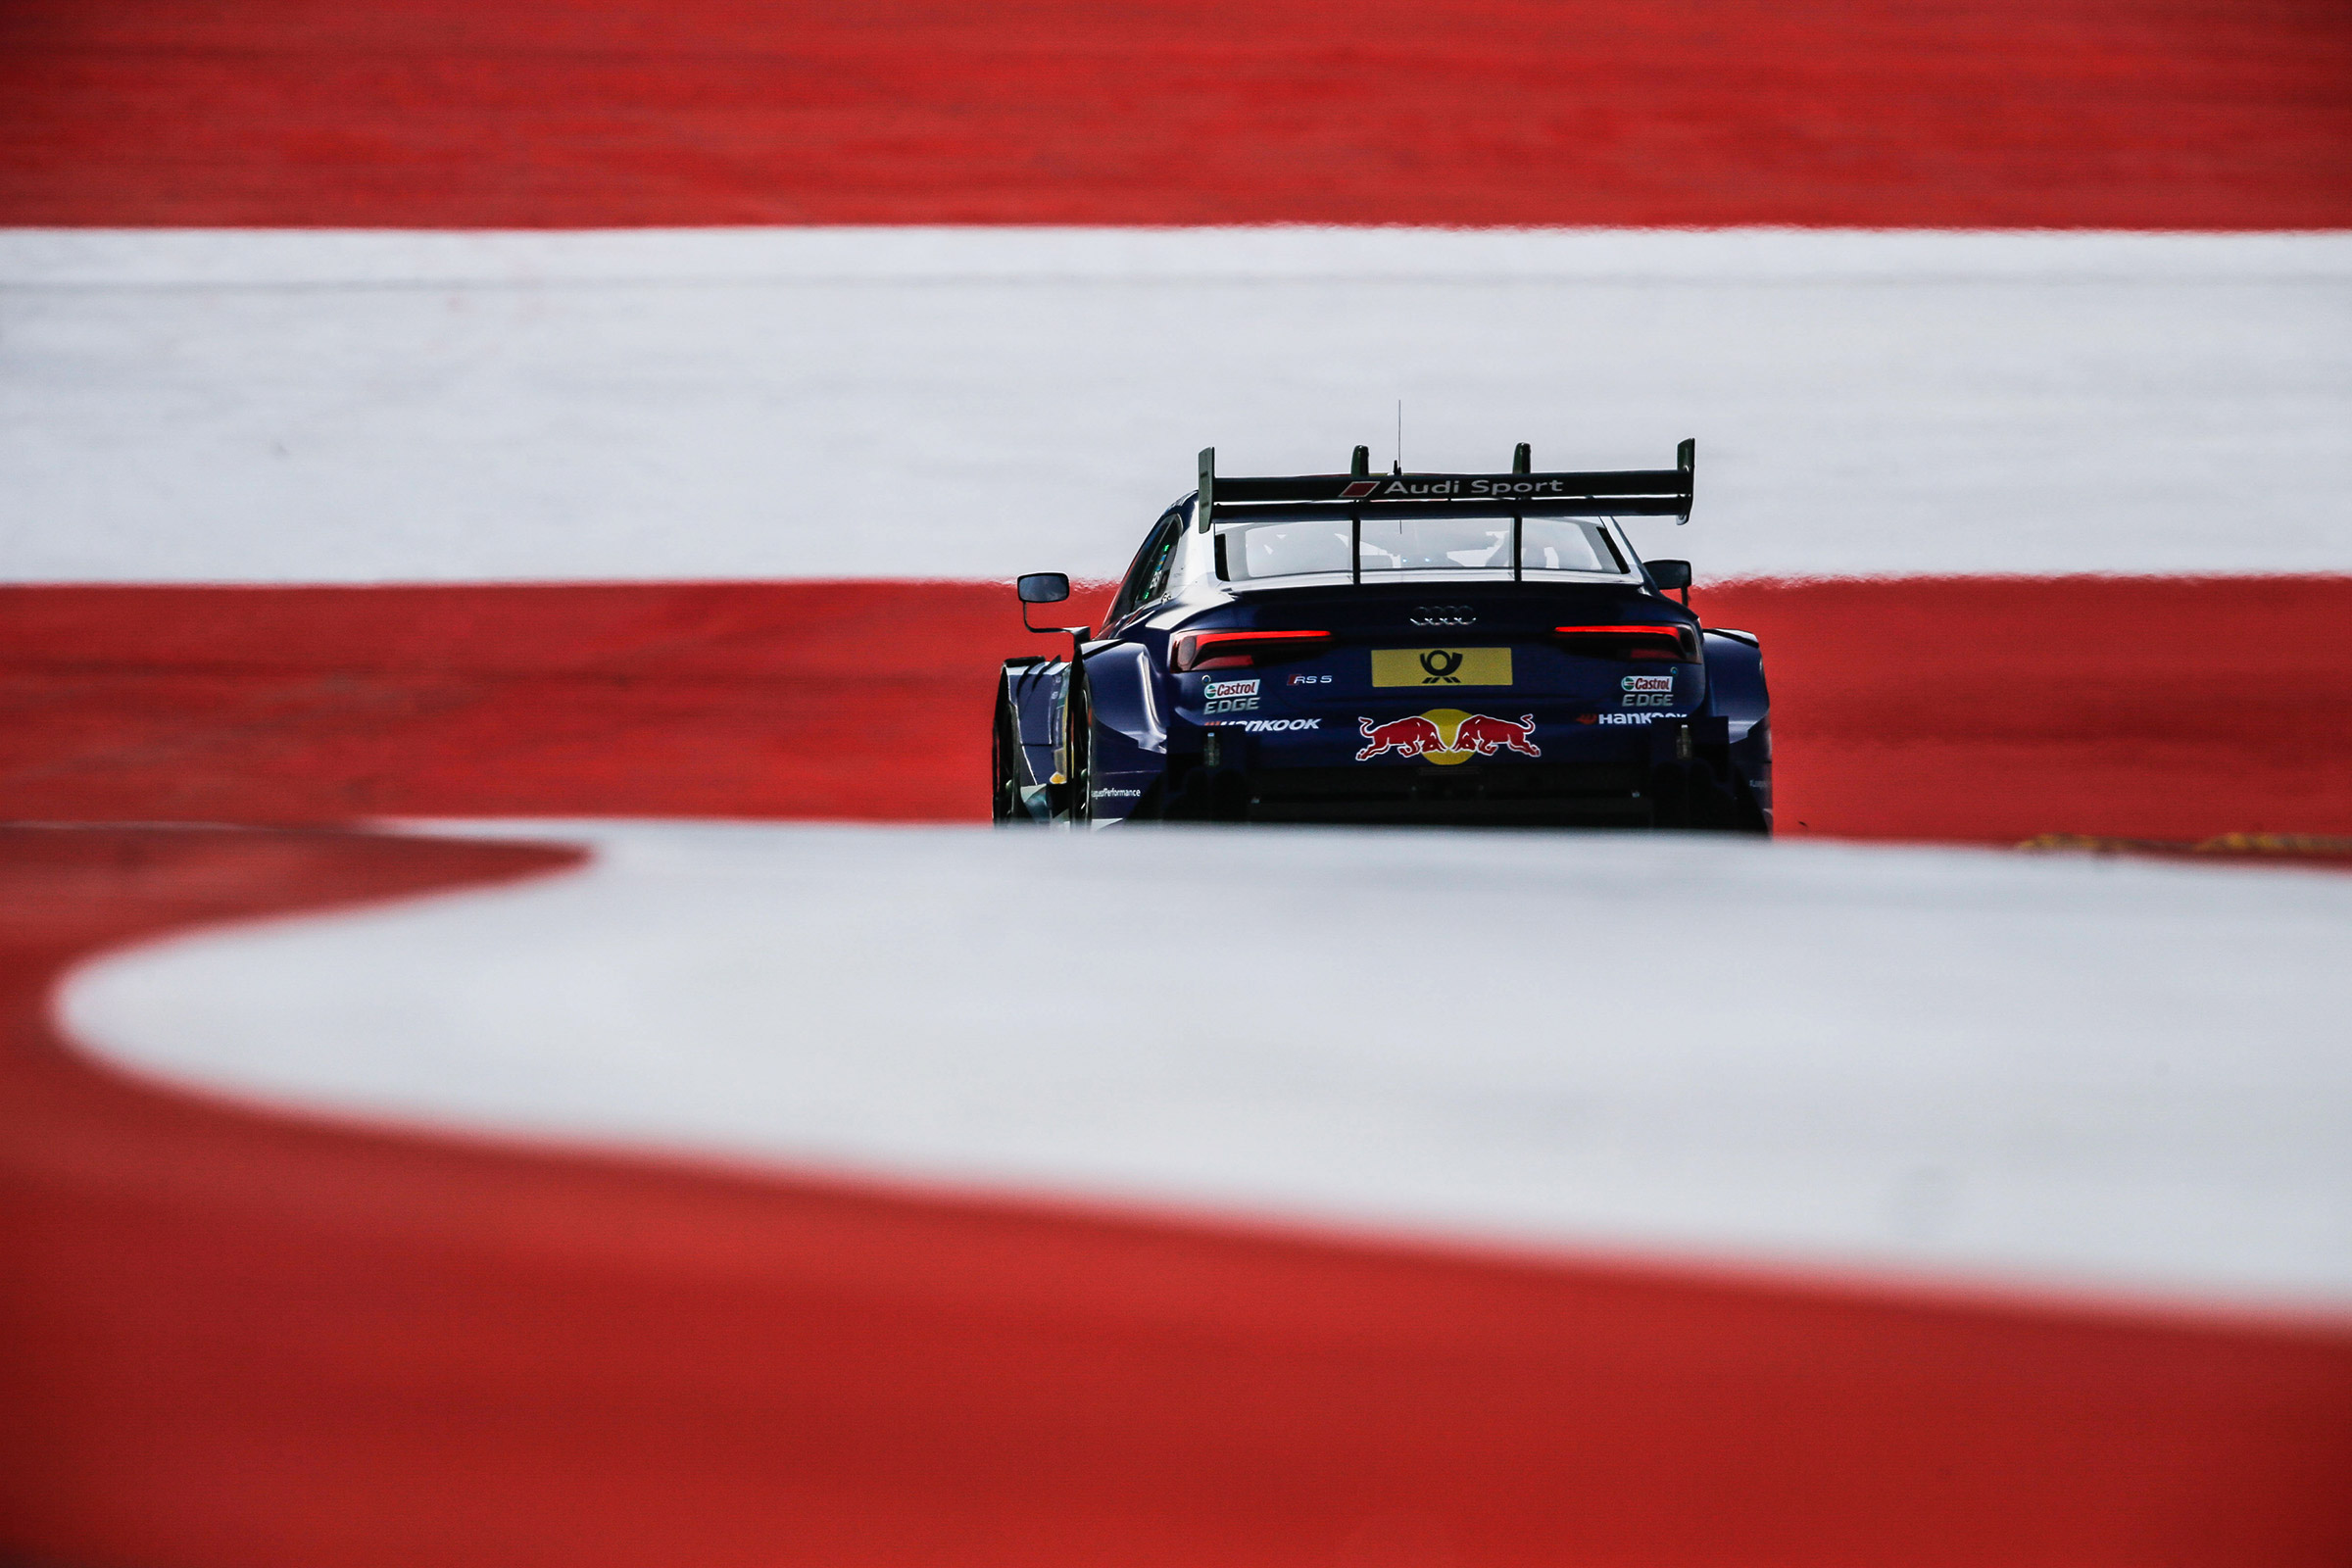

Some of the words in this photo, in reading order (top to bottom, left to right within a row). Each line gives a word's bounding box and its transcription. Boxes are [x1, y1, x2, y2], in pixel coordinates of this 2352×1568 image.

[1384, 480, 1460, 495] Audi
[1470, 479, 1564, 495] Sport
[1294, 675, 1317, 684] RS
[1635, 677, 1670, 690] Castrol
[1216, 682, 1256, 697] Castrol
[1203, 697, 1261, 715] EDGE
[1622, 694, 1674, 708] EDGE
